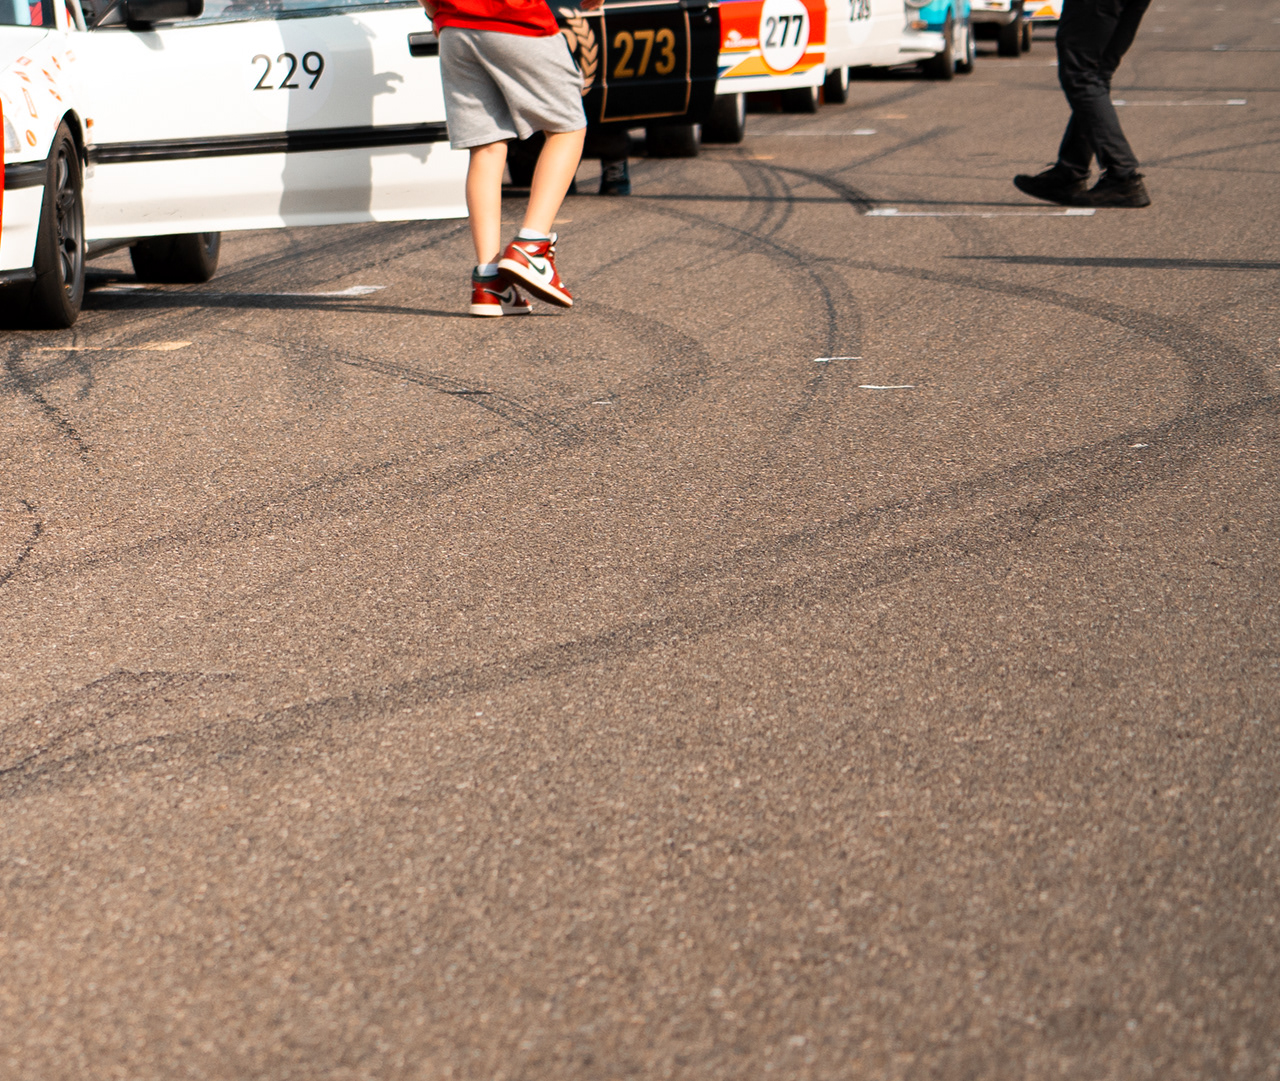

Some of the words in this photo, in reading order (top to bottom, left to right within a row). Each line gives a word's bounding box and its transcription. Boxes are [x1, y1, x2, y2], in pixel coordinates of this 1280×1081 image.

[765, 14, 804, 48] 277
[251, 50, 326, 91] 229
[612, 27, 676, 79] 273
